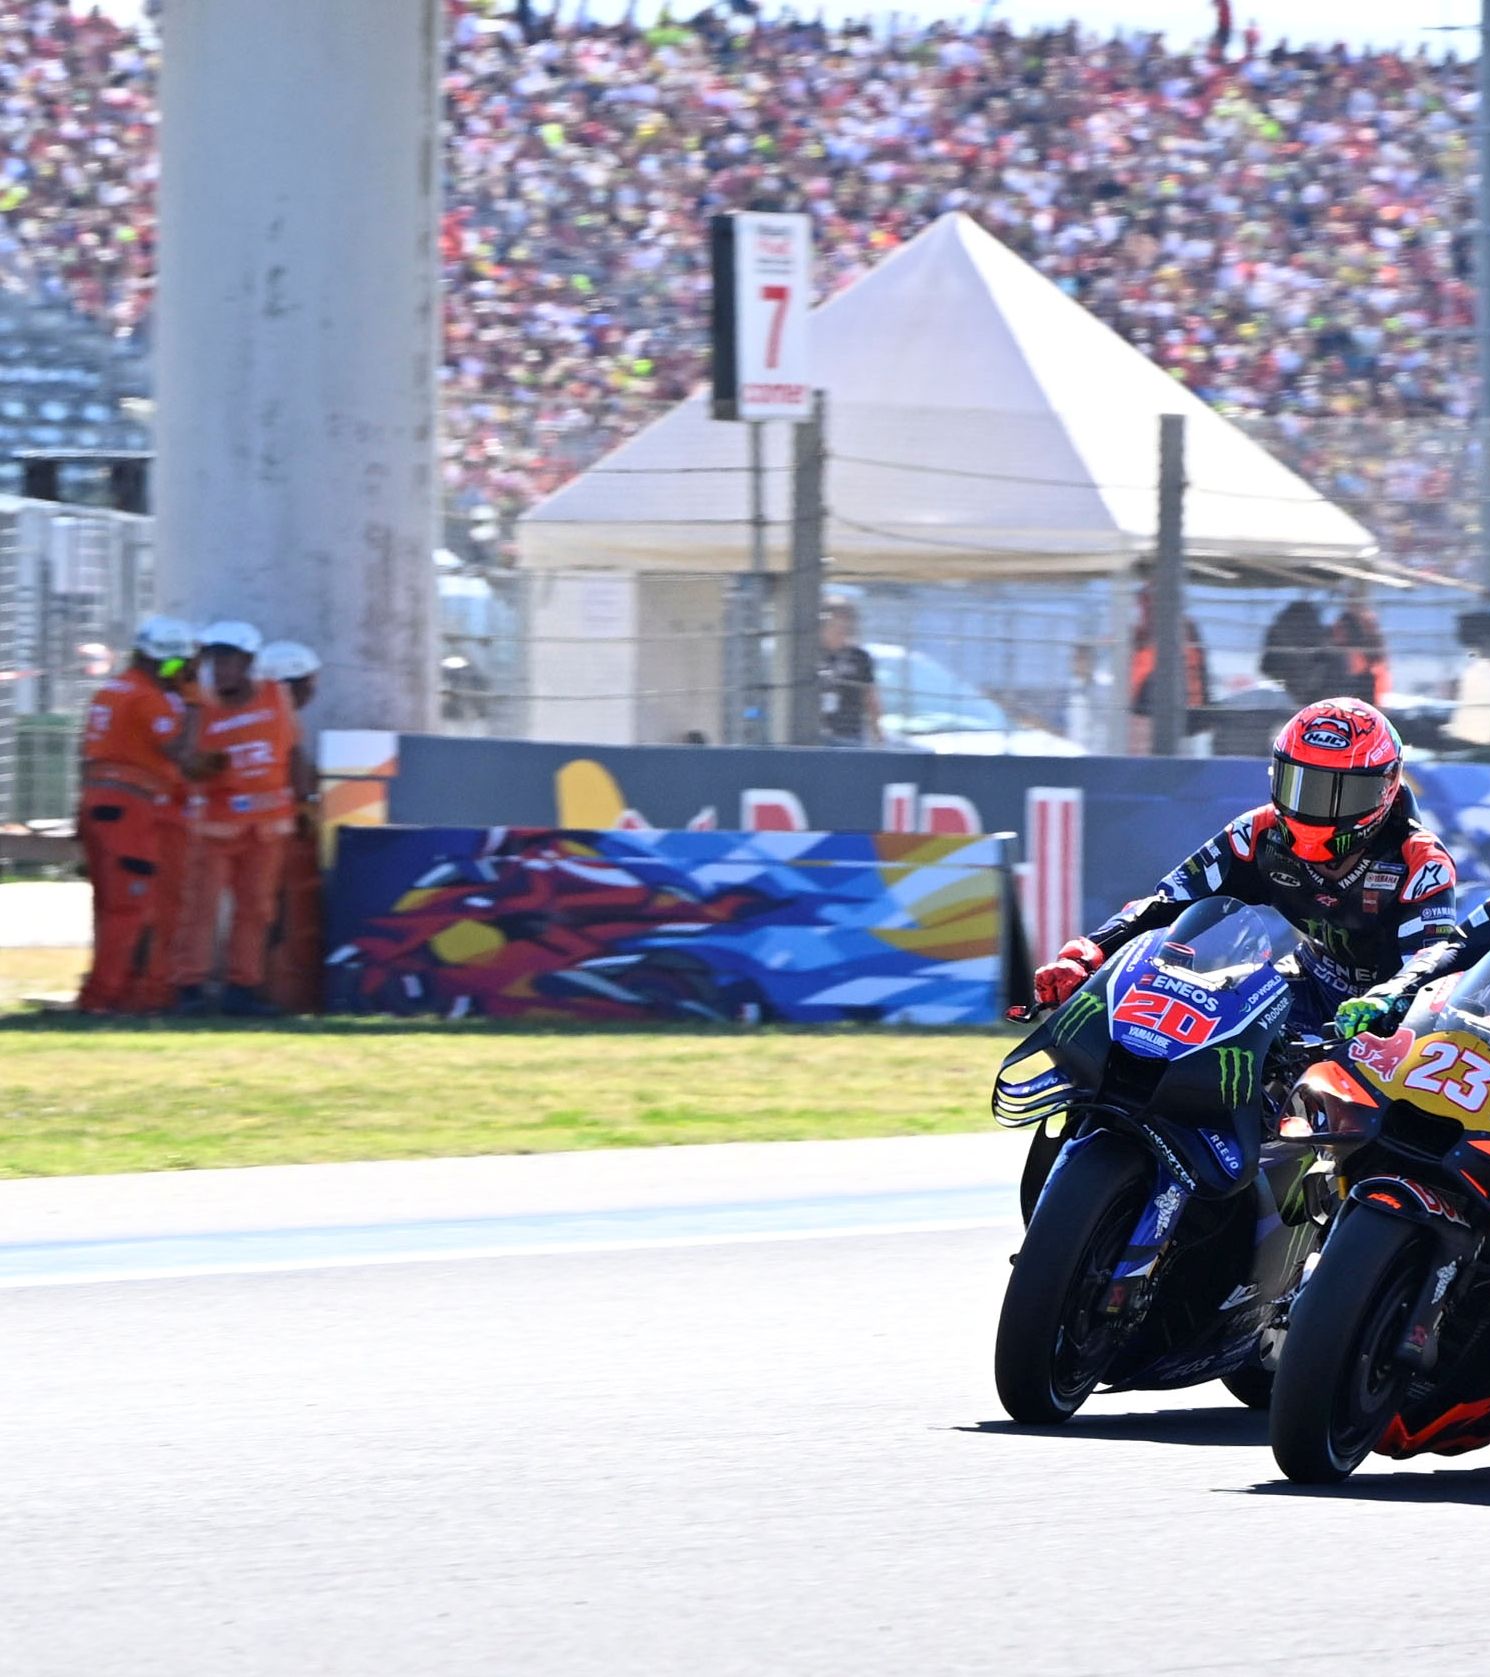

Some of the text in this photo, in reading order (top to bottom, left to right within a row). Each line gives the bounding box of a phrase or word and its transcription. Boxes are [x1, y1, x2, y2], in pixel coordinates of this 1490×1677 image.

[761, 285, 790, 369] 7
[1307, 734, 1342, 747] HJC
[1338, 858, 1371, 890] YAMAHA
[1152, 976, 1219, 1012] ENEOS
[1258, 974, 1283, 998] WORLD
[1113, 983, 1222, 1045] 20
[1127, 1026, 1172, 1048] YAMALUBE
[1209, 1134, 1240, 1171] REEJO
